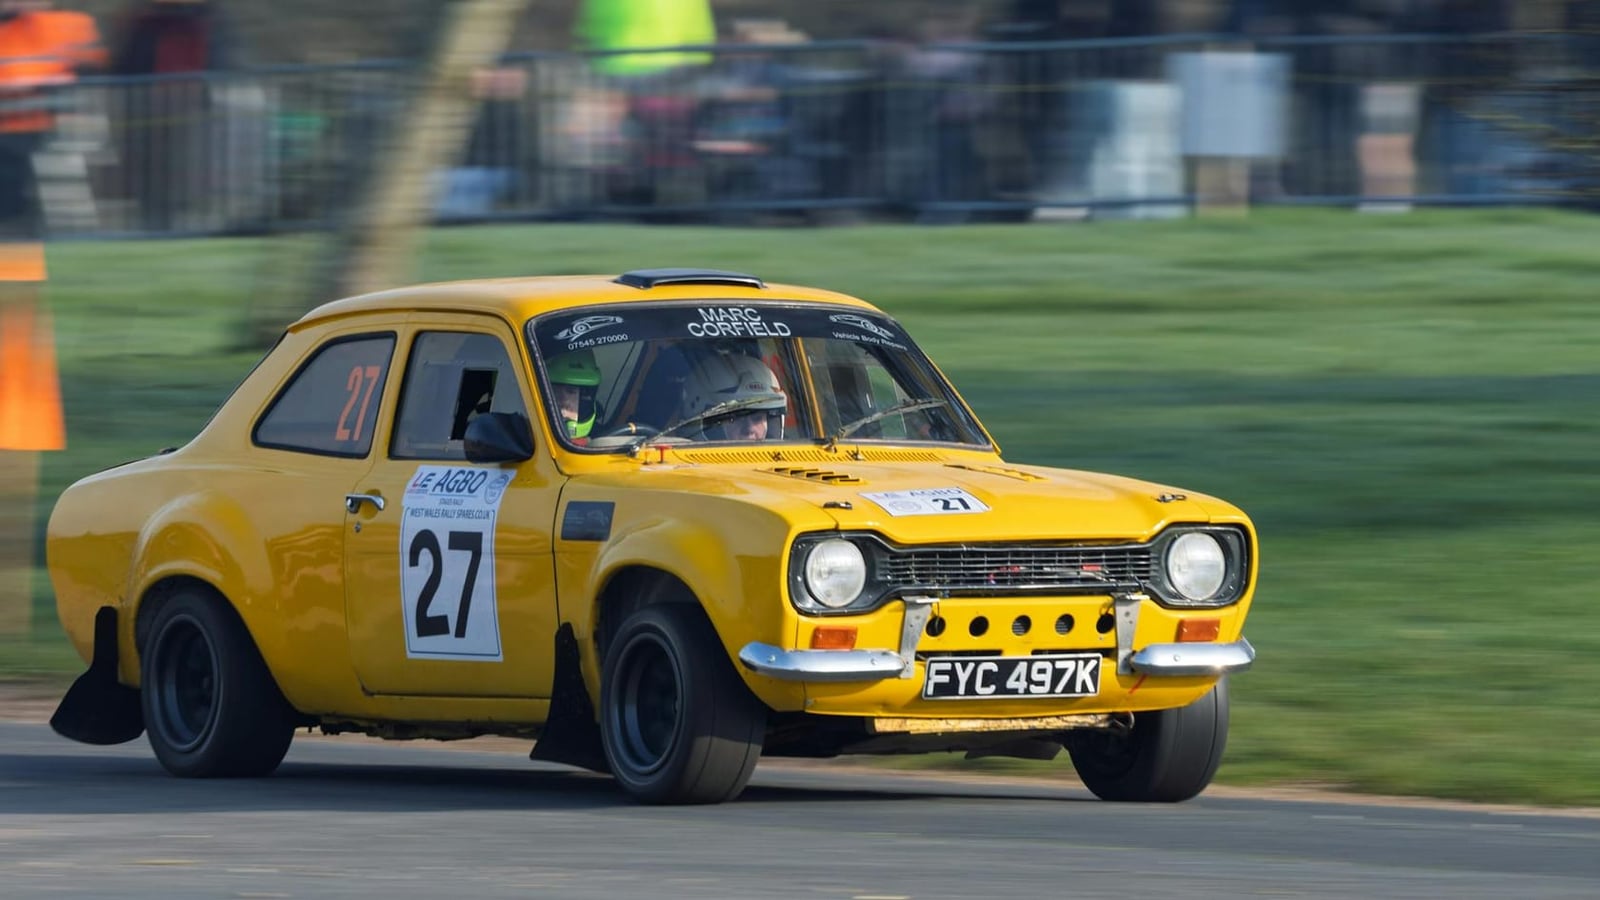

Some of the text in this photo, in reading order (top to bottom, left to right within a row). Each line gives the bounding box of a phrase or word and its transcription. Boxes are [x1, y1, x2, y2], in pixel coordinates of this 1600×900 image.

[698, 308, 761, 322] MARC
[687, 322, 791, 337] CORFIELD
[568, 334, 629, 350] 07545 270000
[832, 331, 860, 341] Vehicle
[861, 335, 880, 344] Body
[335, 365, 381, 441] 27
[412, 472, 436, 489] LE
[432, 469, 488, 494] AGBO
[932, 497, 971, 511] 27
[410, 507, 425, 518] WEST
[424, 508, 441, 518] WALES
[441, 509, 457, 519] RALLY
[409, 529, 484, 638] 27
[927, 659, 1098, 696] FYC 497K
